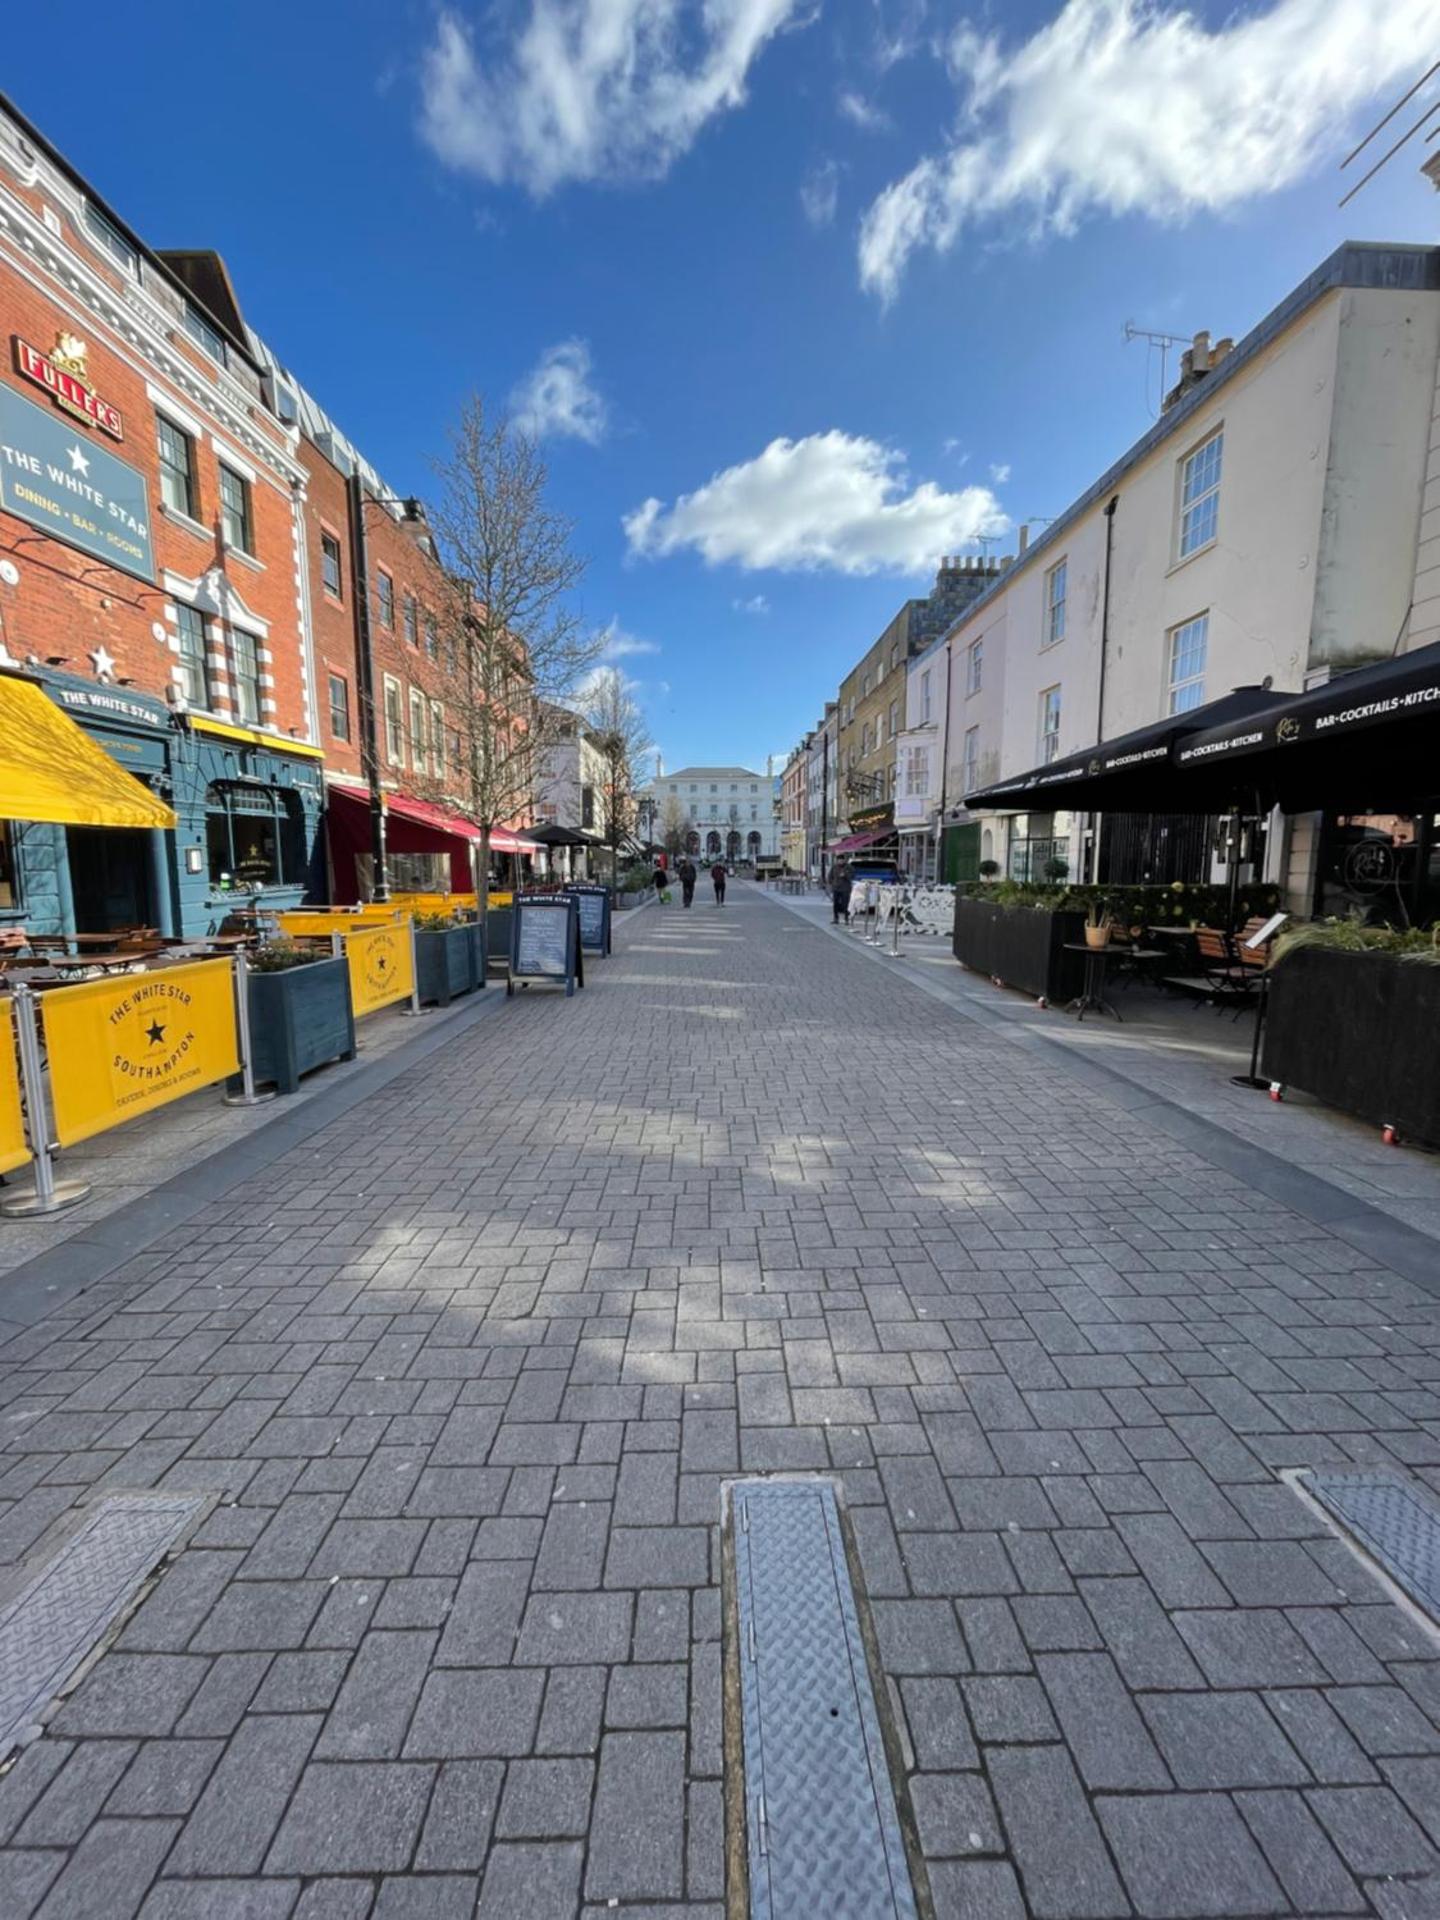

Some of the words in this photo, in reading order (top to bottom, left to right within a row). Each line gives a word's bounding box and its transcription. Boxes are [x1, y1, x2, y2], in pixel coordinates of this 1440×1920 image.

[1, 445, 42, 476] THE
[46, 463, 104, 508] WHITE
[107, 501, 147, 540] STAR
[14, 482, 61, 516] DINING
[61, 690, 88, 706] THE
[89, 693, 129, 713] WHITE
[130, 705, 159, 724] STAR
[110, 1000, 132, 1025] THE
[132, 983, 166, 1004] WHITE
[167, 985, 192, 1006] STAR
[113, 1031, 195, 1079] SOUTHAMPTON
